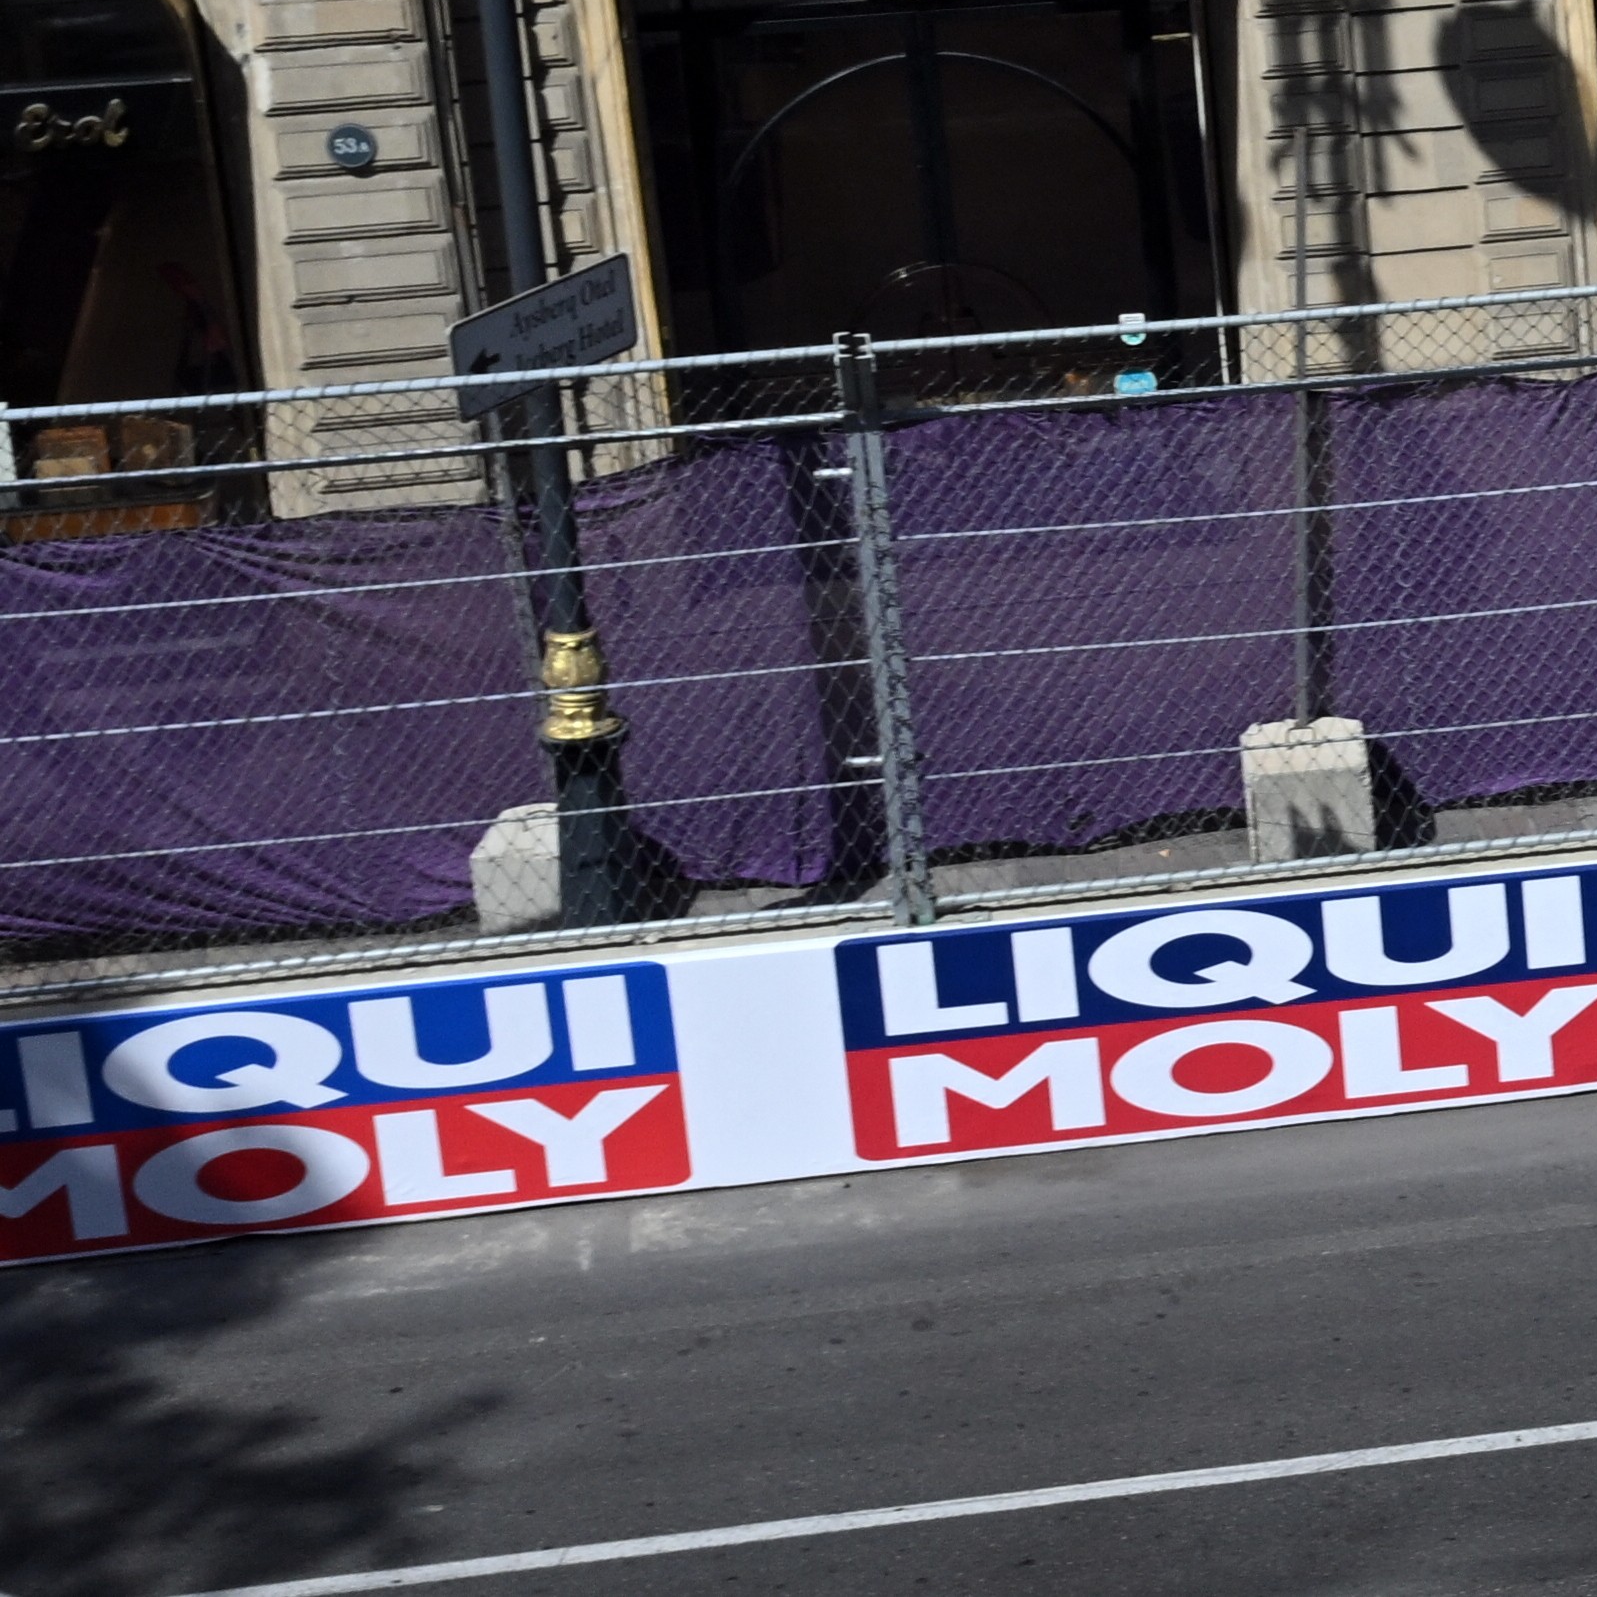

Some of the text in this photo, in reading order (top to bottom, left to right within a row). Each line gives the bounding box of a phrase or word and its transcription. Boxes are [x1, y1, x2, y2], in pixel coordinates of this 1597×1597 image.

[13, 98, 130, 150] Erol
[580, 268, 616, 305] Otel
[579, 307, 624, 351] Hotel
[877, 875, 1586, 1037] LIQUI
[0, 974, 636, 1133] IQUI
